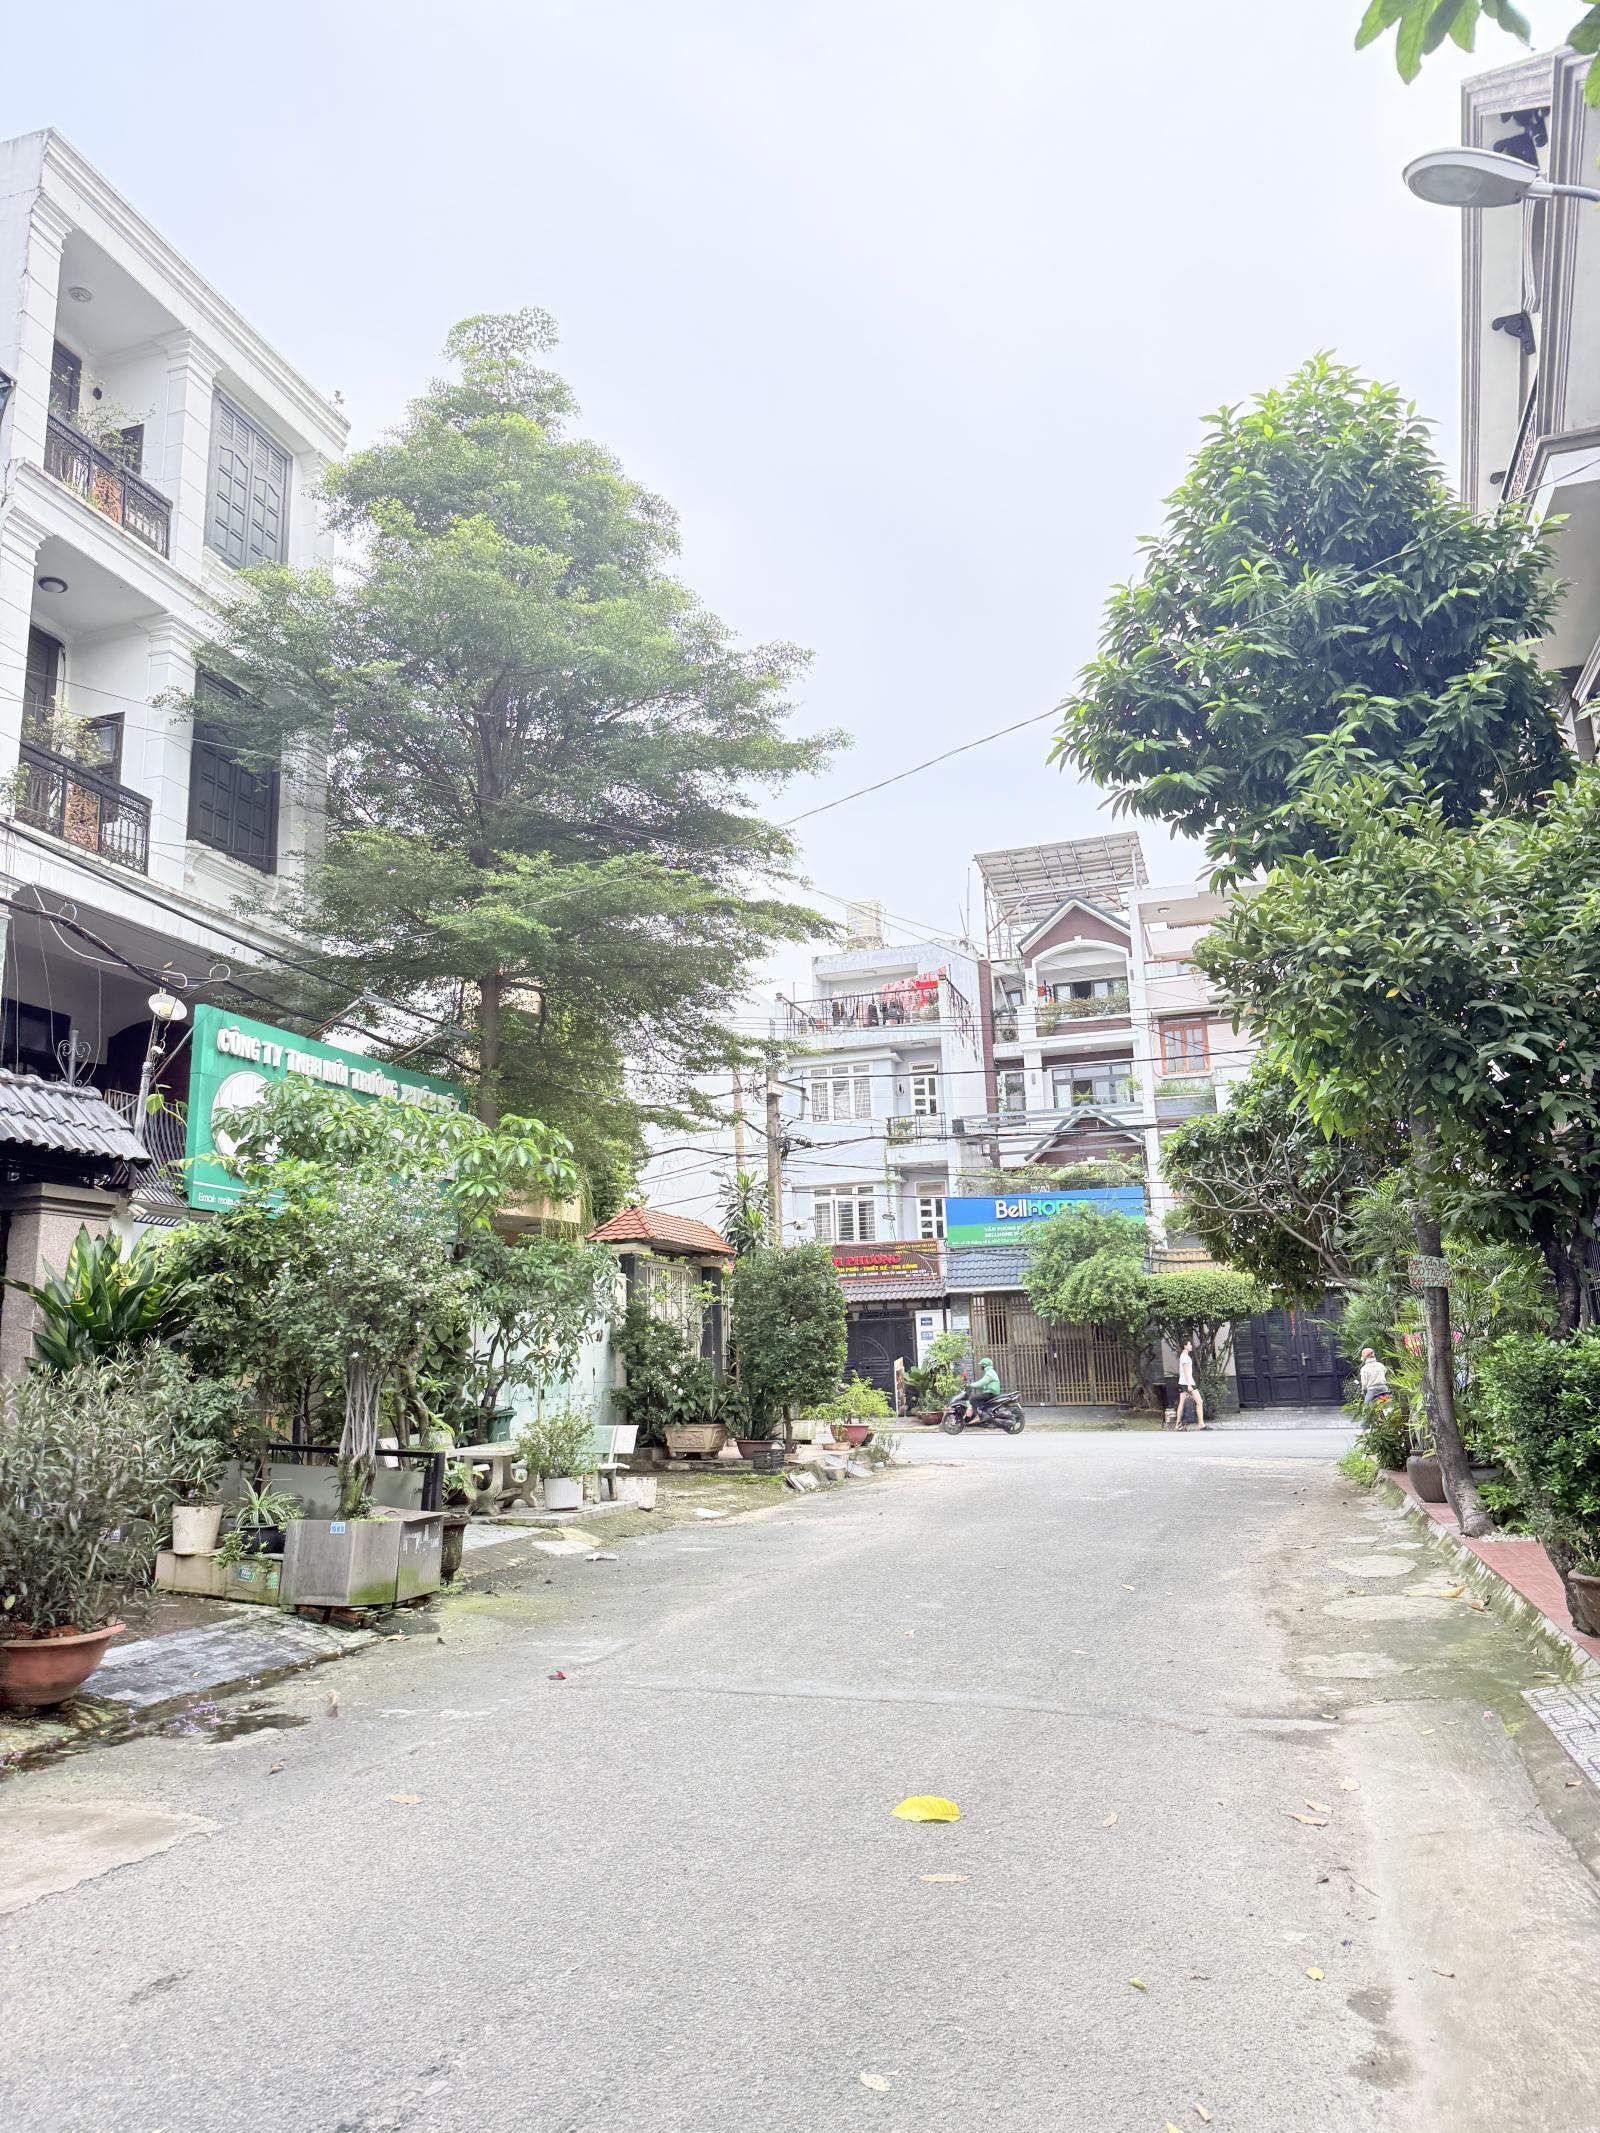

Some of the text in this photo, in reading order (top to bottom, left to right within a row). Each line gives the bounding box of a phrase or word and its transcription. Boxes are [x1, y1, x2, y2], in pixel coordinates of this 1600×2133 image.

[217, 1025, 260, 1062] CÔNG
[261, 1041, 284, 1067] TY
[285, 1048, 323, 1080] TNHH
[323, 1058, 348, 1086] MÔI
